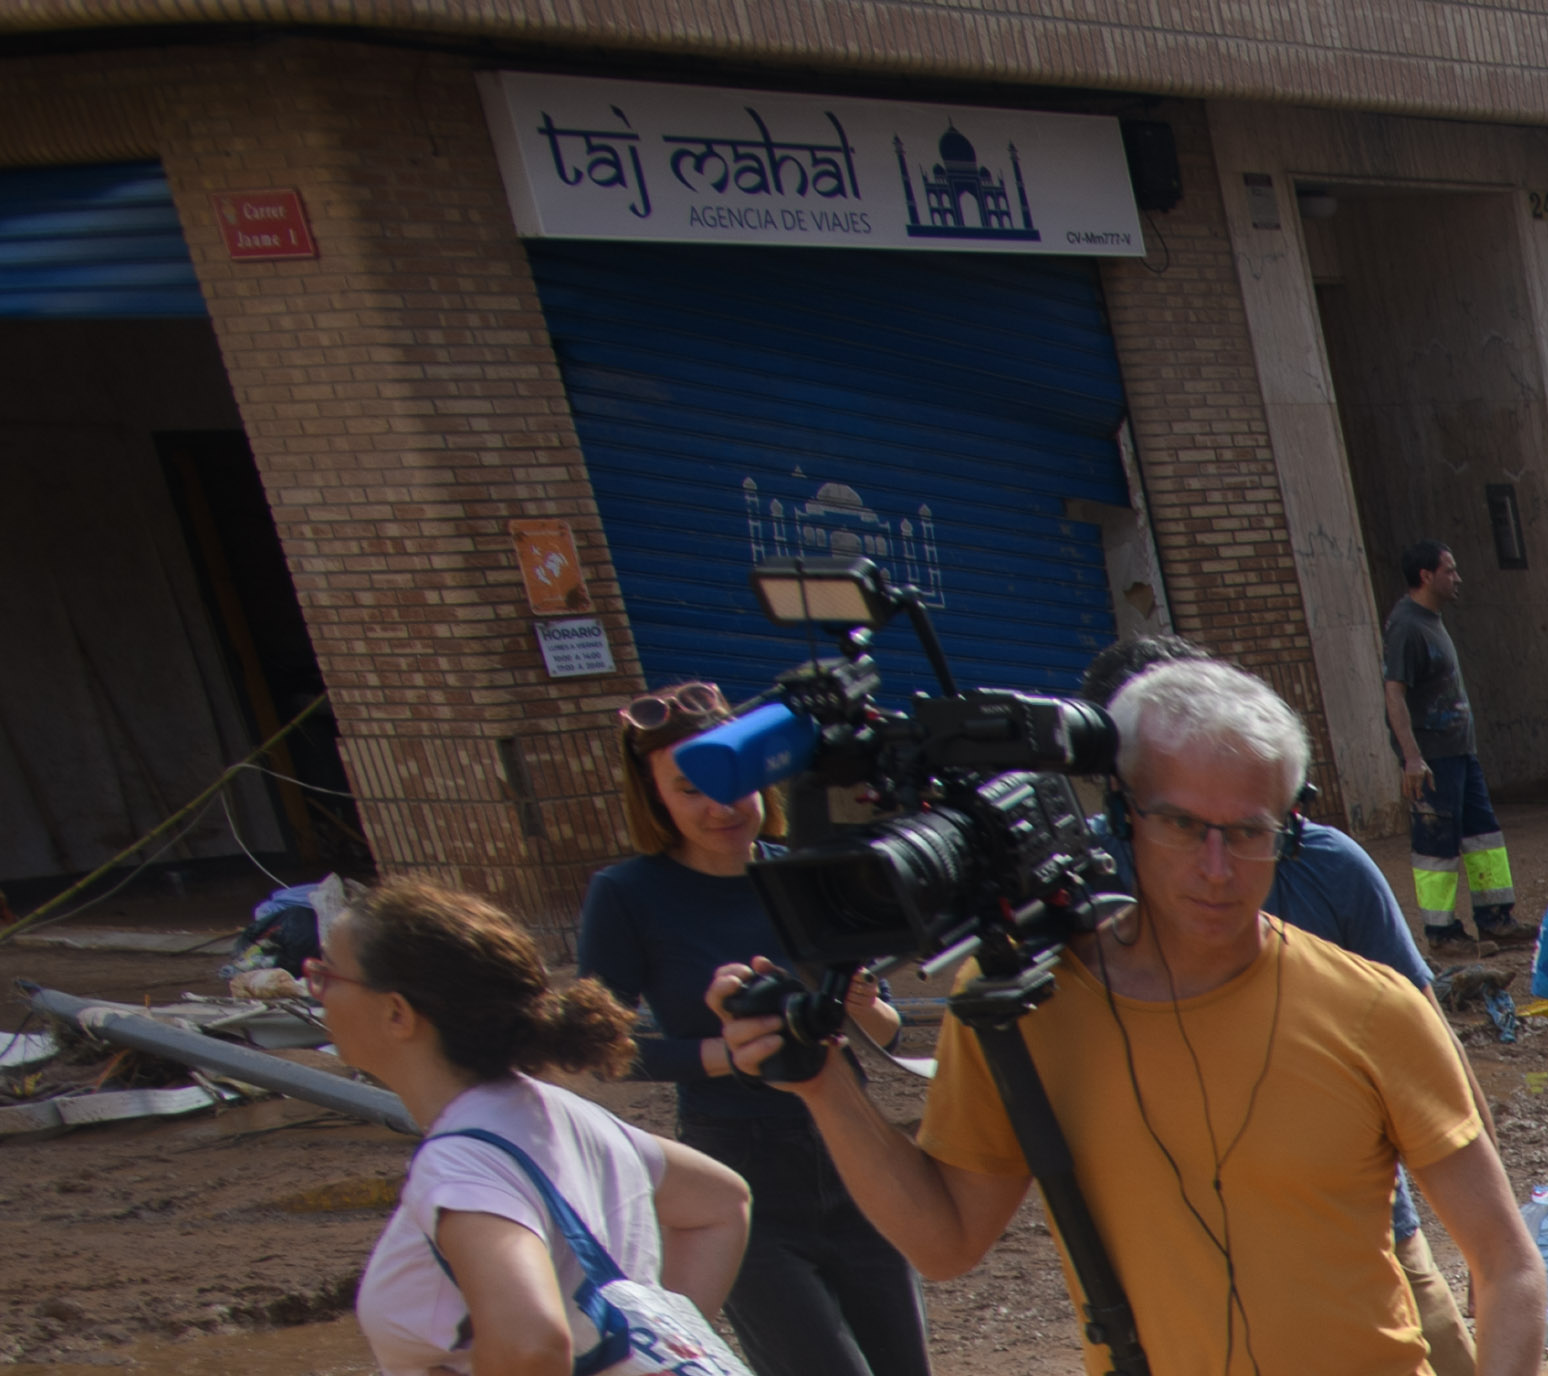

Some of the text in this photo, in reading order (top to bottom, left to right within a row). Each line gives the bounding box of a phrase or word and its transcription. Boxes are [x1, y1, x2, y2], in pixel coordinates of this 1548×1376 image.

[537, 104, 861, 219] taj mahal
[690, 205, 872, 234] AGENCIA DE VIAJES
[543, 626, 601, 641] HORARIO
